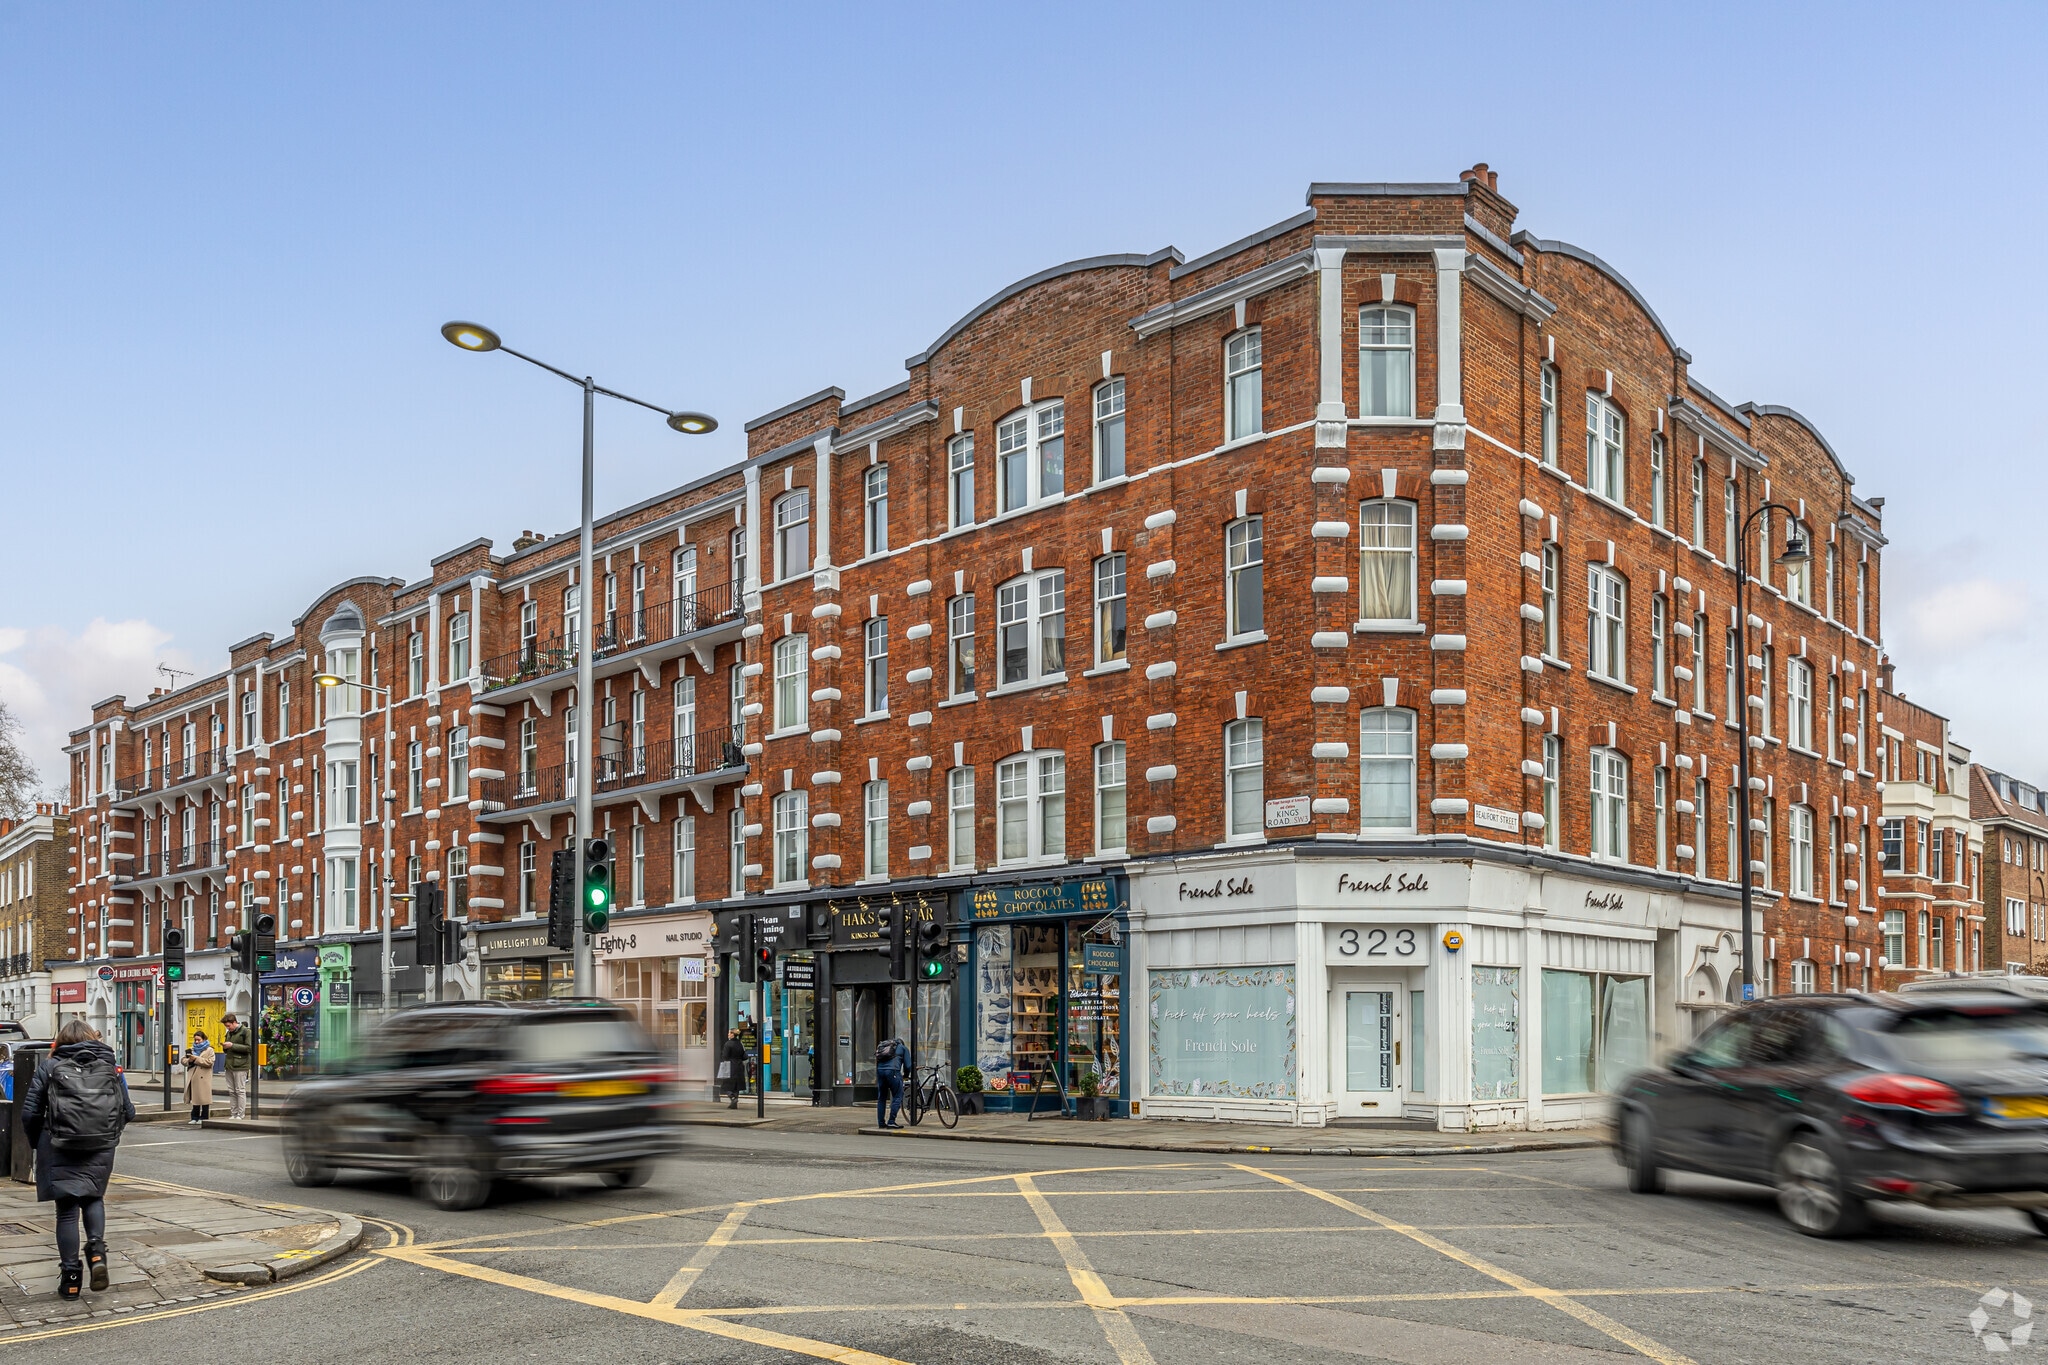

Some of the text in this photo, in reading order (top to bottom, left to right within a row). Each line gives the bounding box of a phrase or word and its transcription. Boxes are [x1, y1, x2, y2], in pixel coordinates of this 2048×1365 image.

[1276, 808, 1299, 818] KINGS
[1475, 810, 1499, 822] BEAUFORT
[1499, 815, 1517, 826] STREET
[1178, 876, 1254, 901] French Sole
[1338, 872, 1429, 893] French Sole
[1014, 886, 1062, 900] ROCOCO
[1584, 890, 1611, 909] French
[1004, 898, 1075, 914] CHOCOLATES
[842, 911, 875, 927] HAKS
[665, 932, 703, 943] NAIL STUDIO
[850, 931, 869, 940] KINGS
[1339, 928, 1416, 956] 323
[489, 937, 530, 950] LIMELIGHT
[600, 933, 637, 954] Eighty-8
[1092, 950, 1115, 958] ROCOCO
[683, 965, 703, 976] NAIL
[1087, 959, 1119, 968] CHOCOLATES
[1192, 1006, 1208, 1023] off
[1213, 1011, 1240, 1025] your
[1246, 1004, 1281, 1021] heels
[188, 1016, 206, 1028] TO LET
[1185, 1039, 1257, 1053] French Sole
